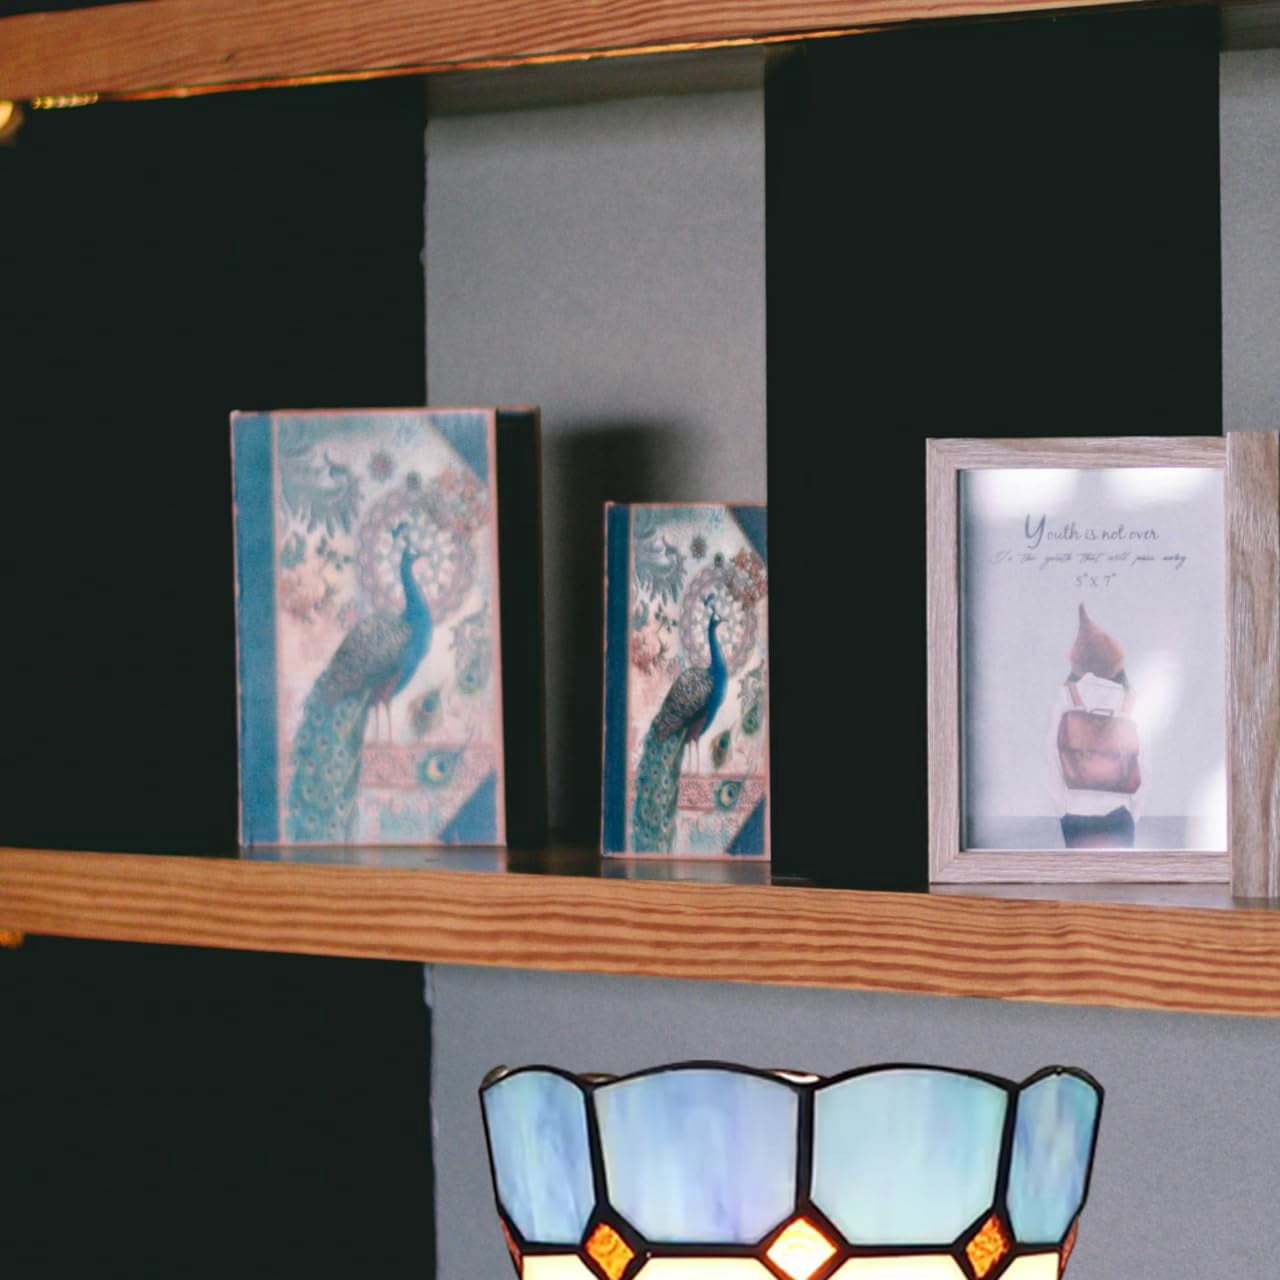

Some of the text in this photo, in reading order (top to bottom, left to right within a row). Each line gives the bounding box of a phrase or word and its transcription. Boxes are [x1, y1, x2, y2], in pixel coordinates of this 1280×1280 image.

[1023, 513, 1081, 549] Youth
[1084, 523, 1098, 541] is
[1102, 524, 1128, 541] not
